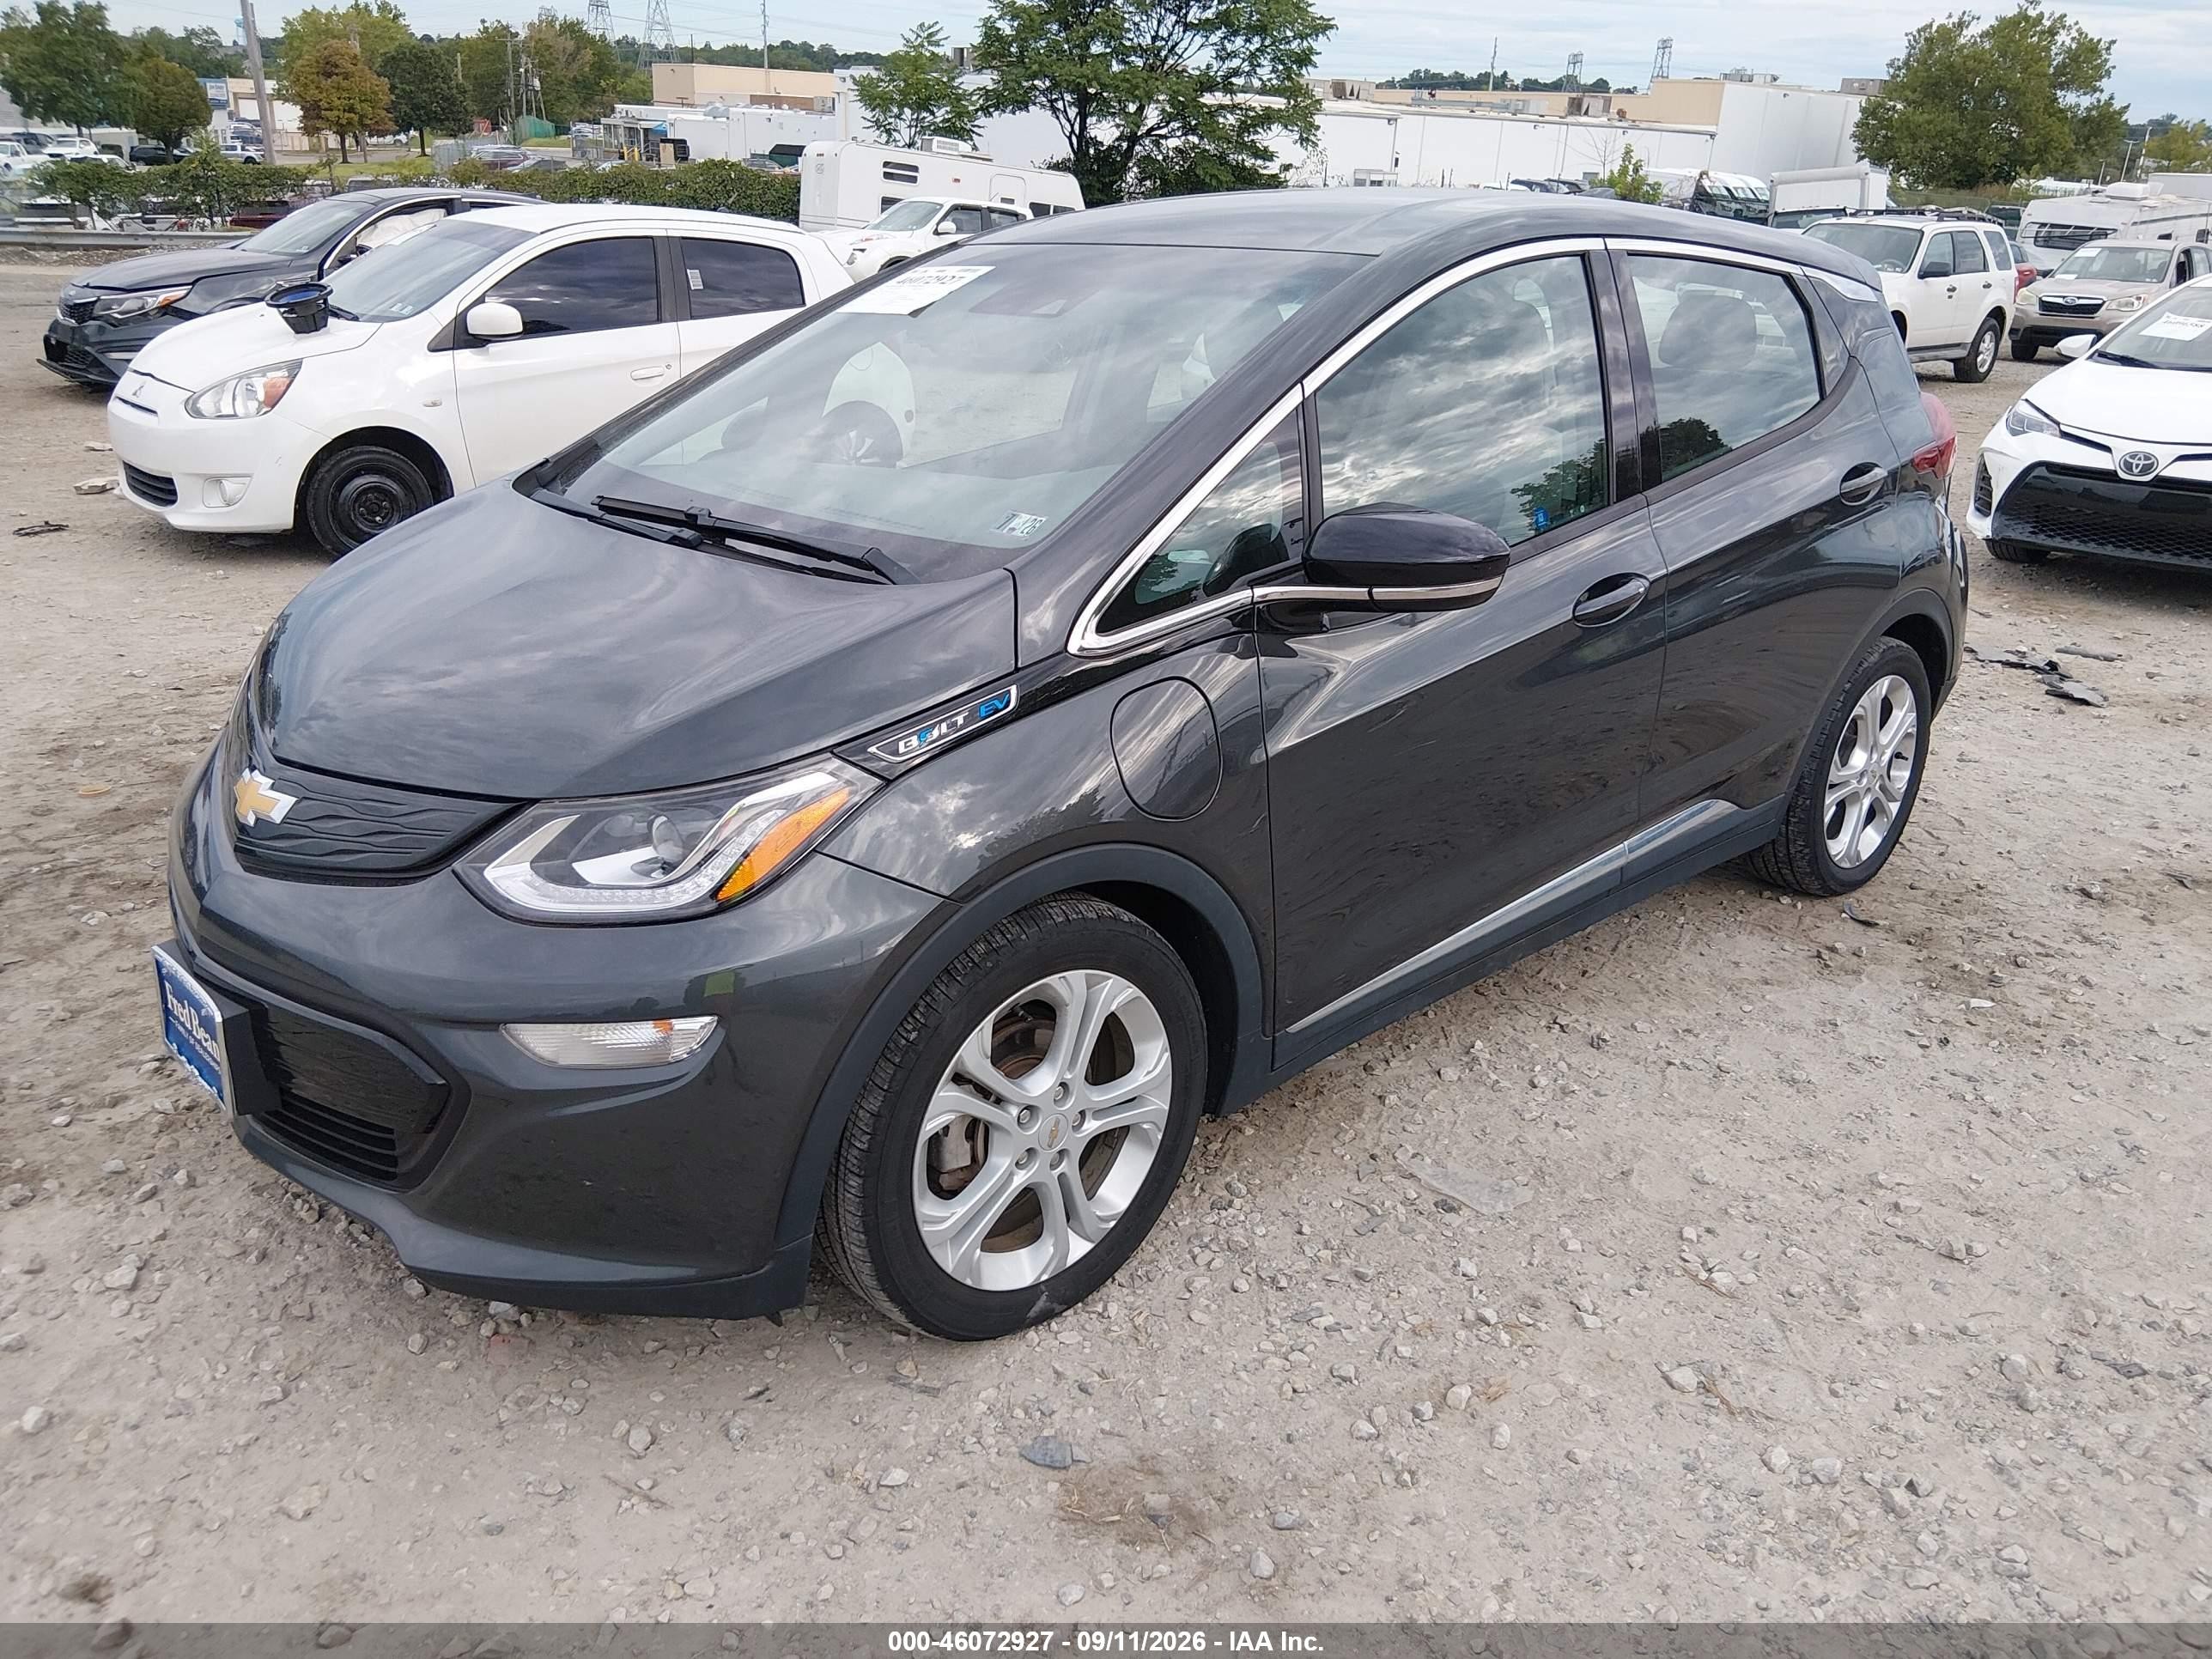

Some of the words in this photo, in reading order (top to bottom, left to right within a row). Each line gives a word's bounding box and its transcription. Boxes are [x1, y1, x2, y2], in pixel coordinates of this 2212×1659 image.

[897, 711, 970, 754] BOLT
[977, 693, 1010, 720] EV
[165, 981, 192, 1030] Fred
